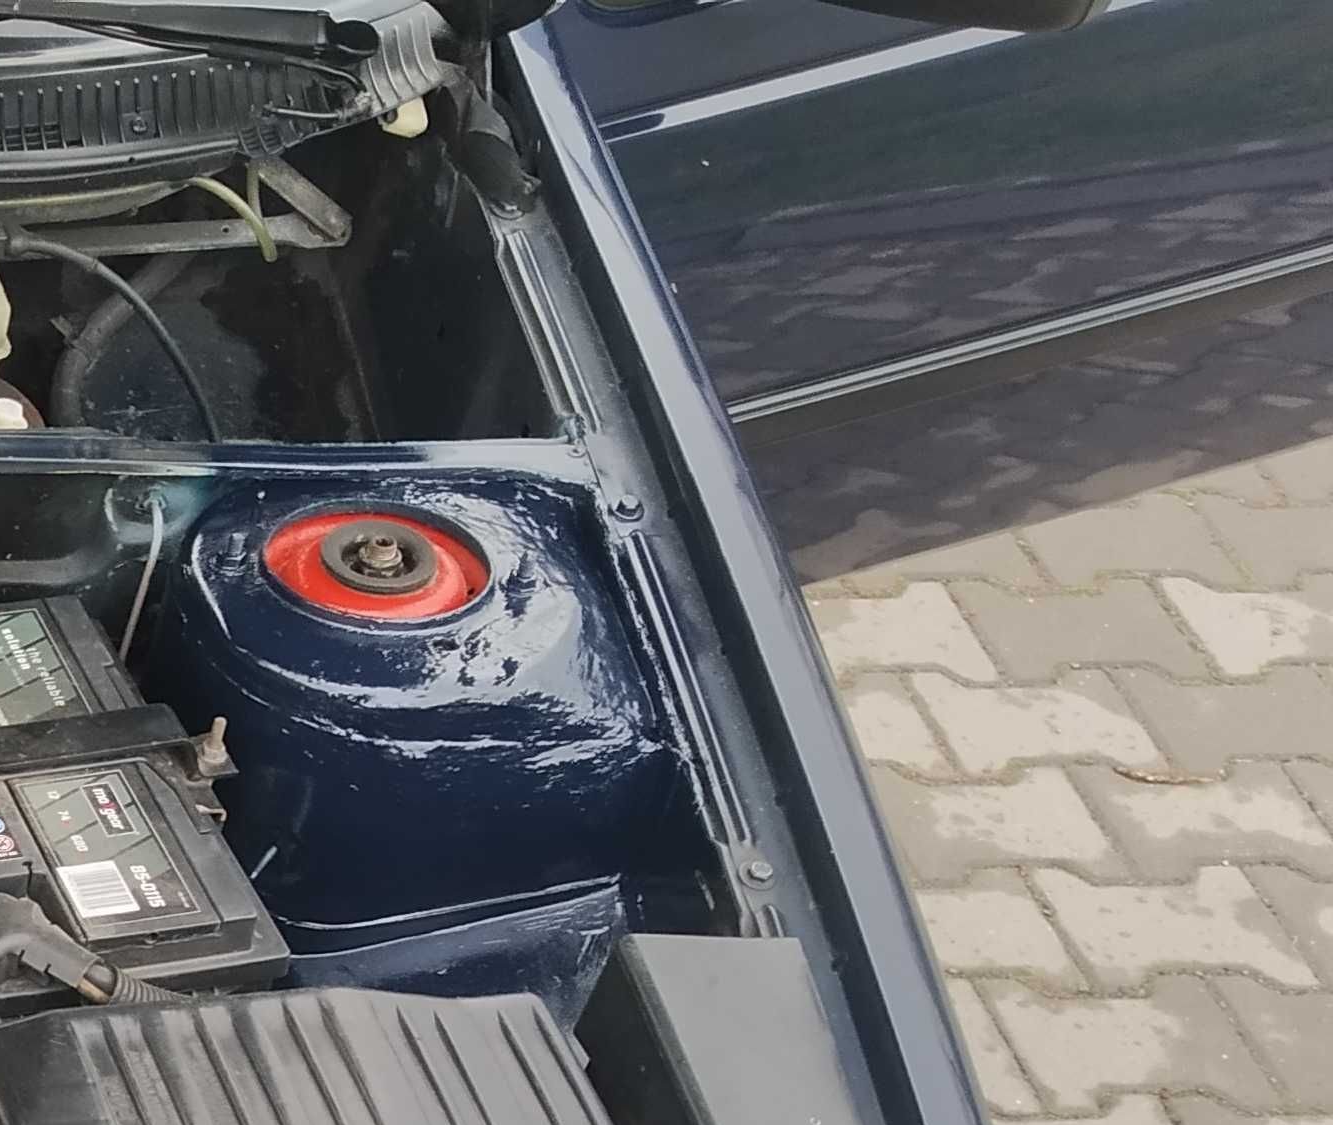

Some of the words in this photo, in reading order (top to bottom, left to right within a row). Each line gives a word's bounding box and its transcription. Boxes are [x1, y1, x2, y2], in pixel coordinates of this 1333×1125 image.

[1, 628, 30, 670] solution
[26, 647, 42, 664] the
[37, 666, 65, 707] reliable
[130, 865, 166, 908] 85-0115
